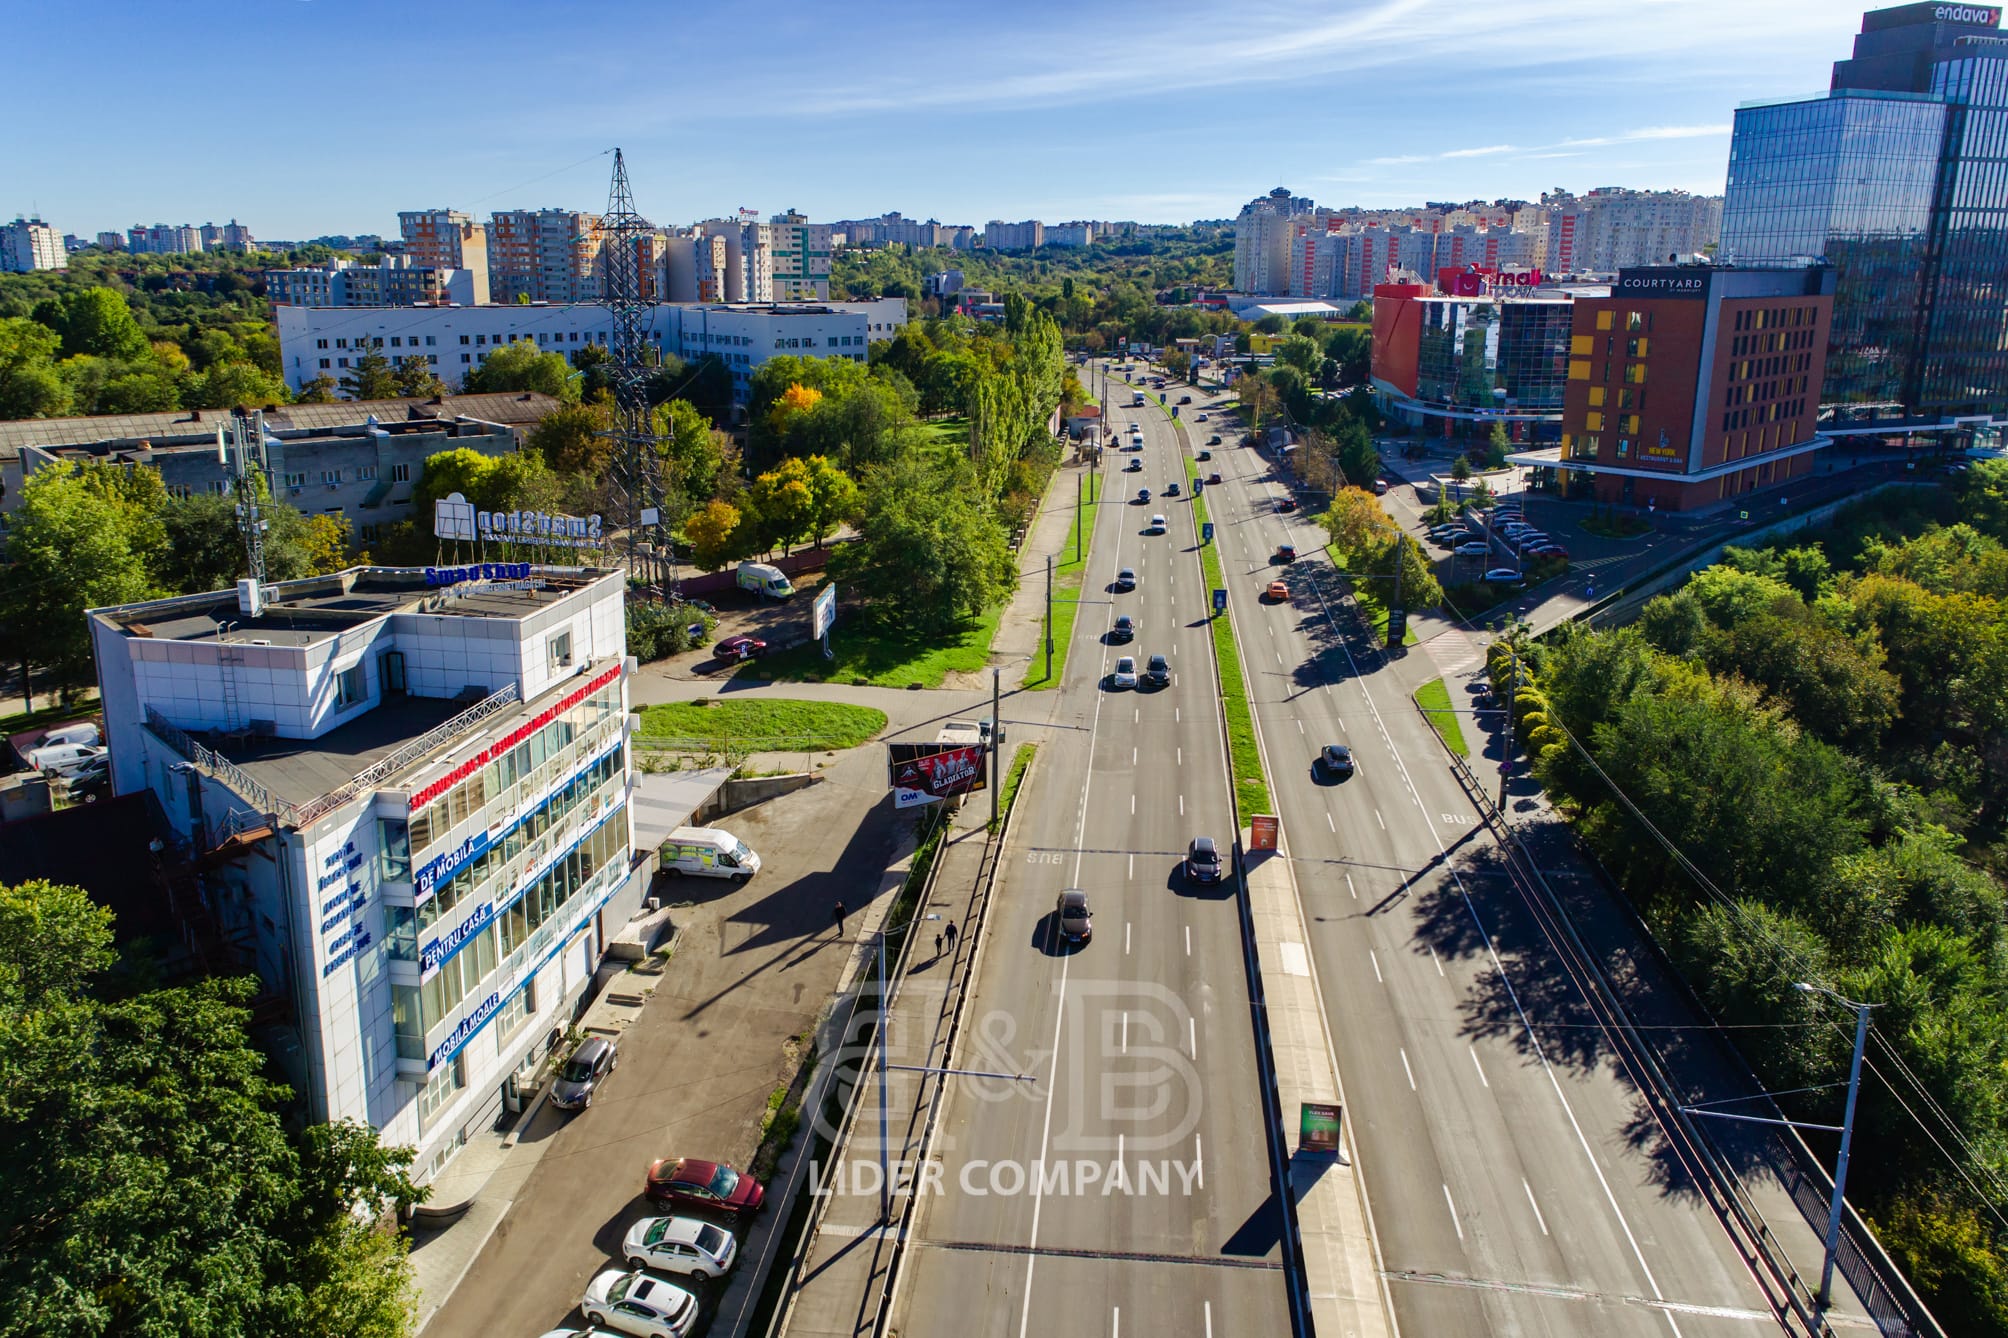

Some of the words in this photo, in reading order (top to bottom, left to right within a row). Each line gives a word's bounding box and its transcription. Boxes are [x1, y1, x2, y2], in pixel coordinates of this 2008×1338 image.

[1935, 5, 1989, 24] endava
[1496, 268, 1541, 286] mall
[1624, 279, 1703, 288] COURTYARD
[933, 765, 976, 789] GLADIATOR
[1441, 813, 1477, 825] BUS
[420, 872, 434, 892] DE
[436, 839, 475, 881] MOBILĂ
[1026, 850, 1063, 865] BUS
[425, 930, 462, 970] PENTRU
[462, 905, 487, 937] CASĂ
[433, 1019, 470, 1065] MOBILĂ
[469, 993, 500, 1030] MOALE
